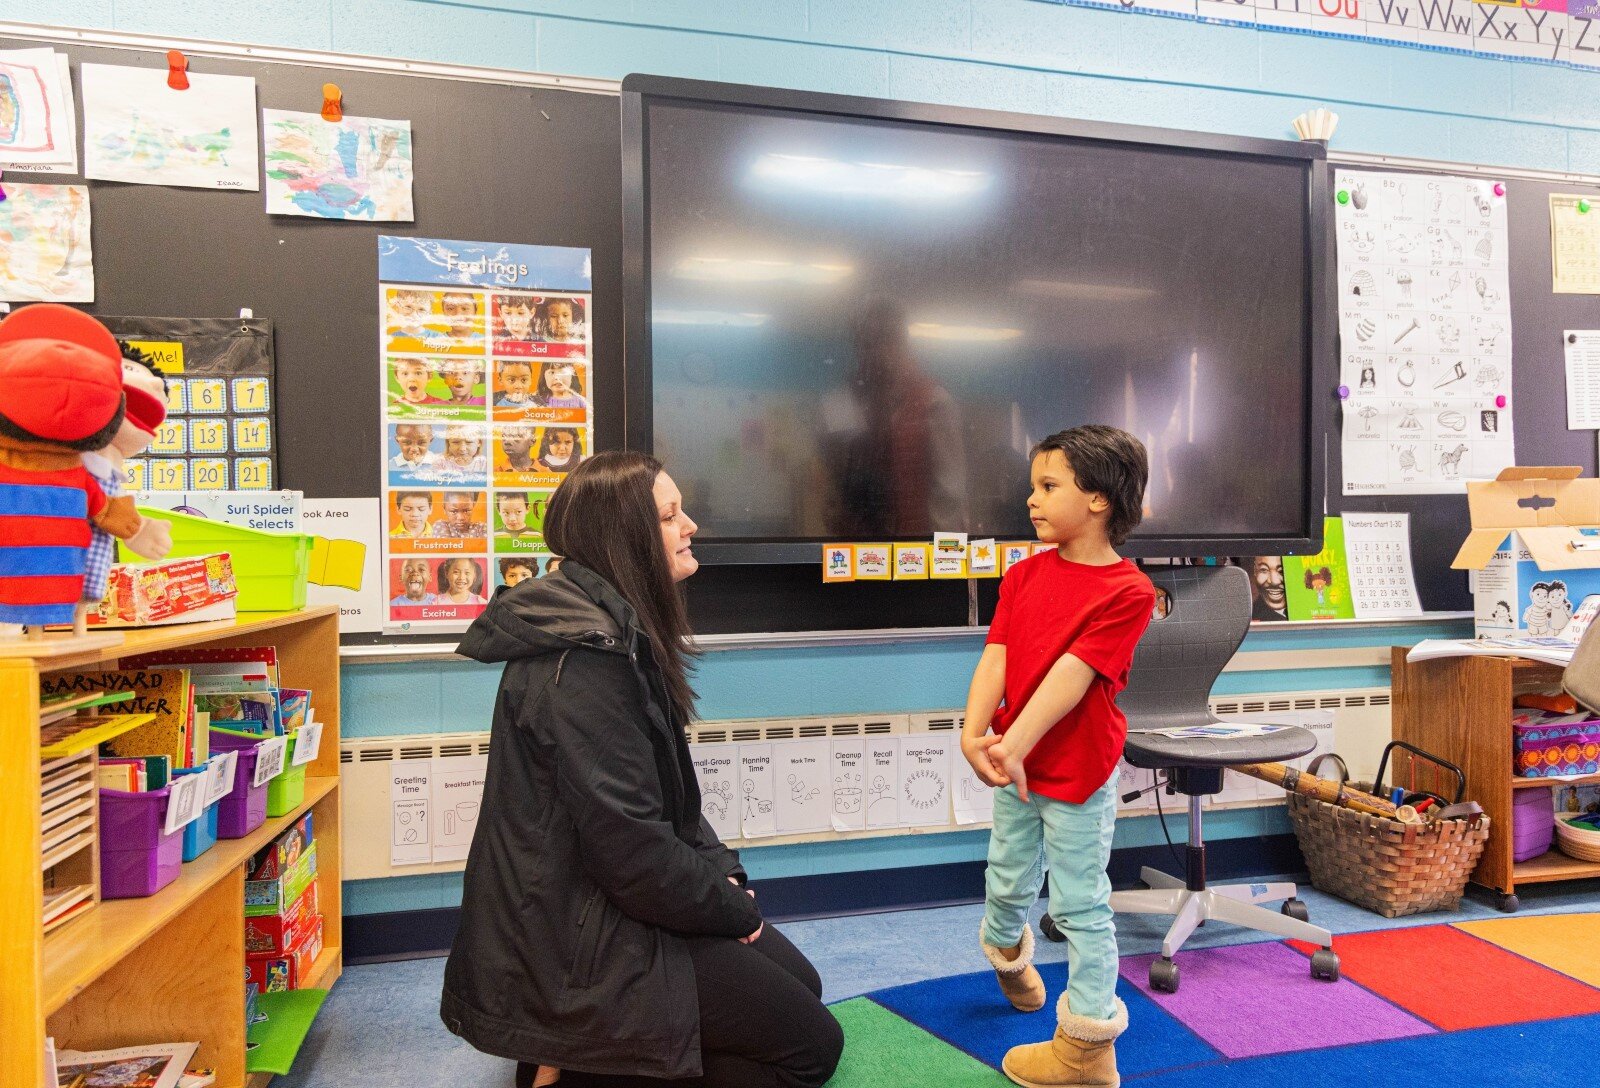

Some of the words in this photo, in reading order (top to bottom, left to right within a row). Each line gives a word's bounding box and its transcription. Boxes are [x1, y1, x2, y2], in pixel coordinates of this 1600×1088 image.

[1478, 4, 1517, 41] Xx
[1525, 9, 1563, 60] Yy
[1574, 16, 1600, 52] Z
[447, 253, 529, 282] Feelings
[421, 340, 452, 353] Happy
[530, 343, 548, 354] Sad
[151, 350, 178, 363] Me!
[202, 388, 212, 404] 6
[246, 387, 255, 404] 7
[415, 406, 460, 417] Surprised
[524, 409, 556, 420] Scared
[158, 428, 175, 444] 12
[199, 428, 216, 444] 13
[243, 427, 259, 442] 14
[127, 468, 135, 484] 8
[158, 468, 175, 484] 19
[198, 467, 218, 483] 20
[243, 466, 260, 482] 21
[424, 473, 454, 485] Angry
[520, 475, 560, 484] Worried
[227, 504, 250, 515] Suri
[253, 504, 294, 518] Spider
[303, 510, 322, 518] ook
[325, 510, 349, 518] Area
[248, 518, 294, 530] Selects
[1348, 520, 1373, 528] Numbers
[1374, 520, 1388, 528] Chart
[1390, 520, 1402, 528] 1-30
[413, 540, 464, 550] Frustrated
[512, 539, 547, 552] Disappo
[1395, 554, 1403, 562] 10
[1366, 566, 1373, 574] 12
[1376, 566, 1383, 574] 13
[1387, 566, 1394, 574] 14
[1397, 566, 1404, 574] 15
[1399, 577, 1407, 585] 20
[1358, 589, 1366, 597] 21
[1369, 589, 1377, 597] 22
[1380, 589, 1388, 597] 23
[1390, 589, 1398, 597] 24
[1401, 588, 1409, 597] 25
[1360, 601, 1368, 609] 26
[1371, 601, 1379, 609] 27
[1393, 600, 1401, 608] 29
[1404, 600, 1412, 608] 30
[340, 607, 362, 616] bros
[422, 608, 457, 618] Excited
[42, 671, 163, 693] BARNYARD
[98, 696, 173, 716] ANTER
[1303, 722, 1333, 730] Dismissal
[835, 752, 862, 760] Cleanup
[873, 750, 893, 758] Recall
[906, 749, 944, 757] Large-Group
[692, 758, 731, 767] mall-Group
[742, 757, 770, 765] Planning
[749, 765, 764, 773] Time
[394, 776, 427, 786] Greeting
[444, 781, 471, 789] Breakfast
[401, 786, 420, 794] Time
